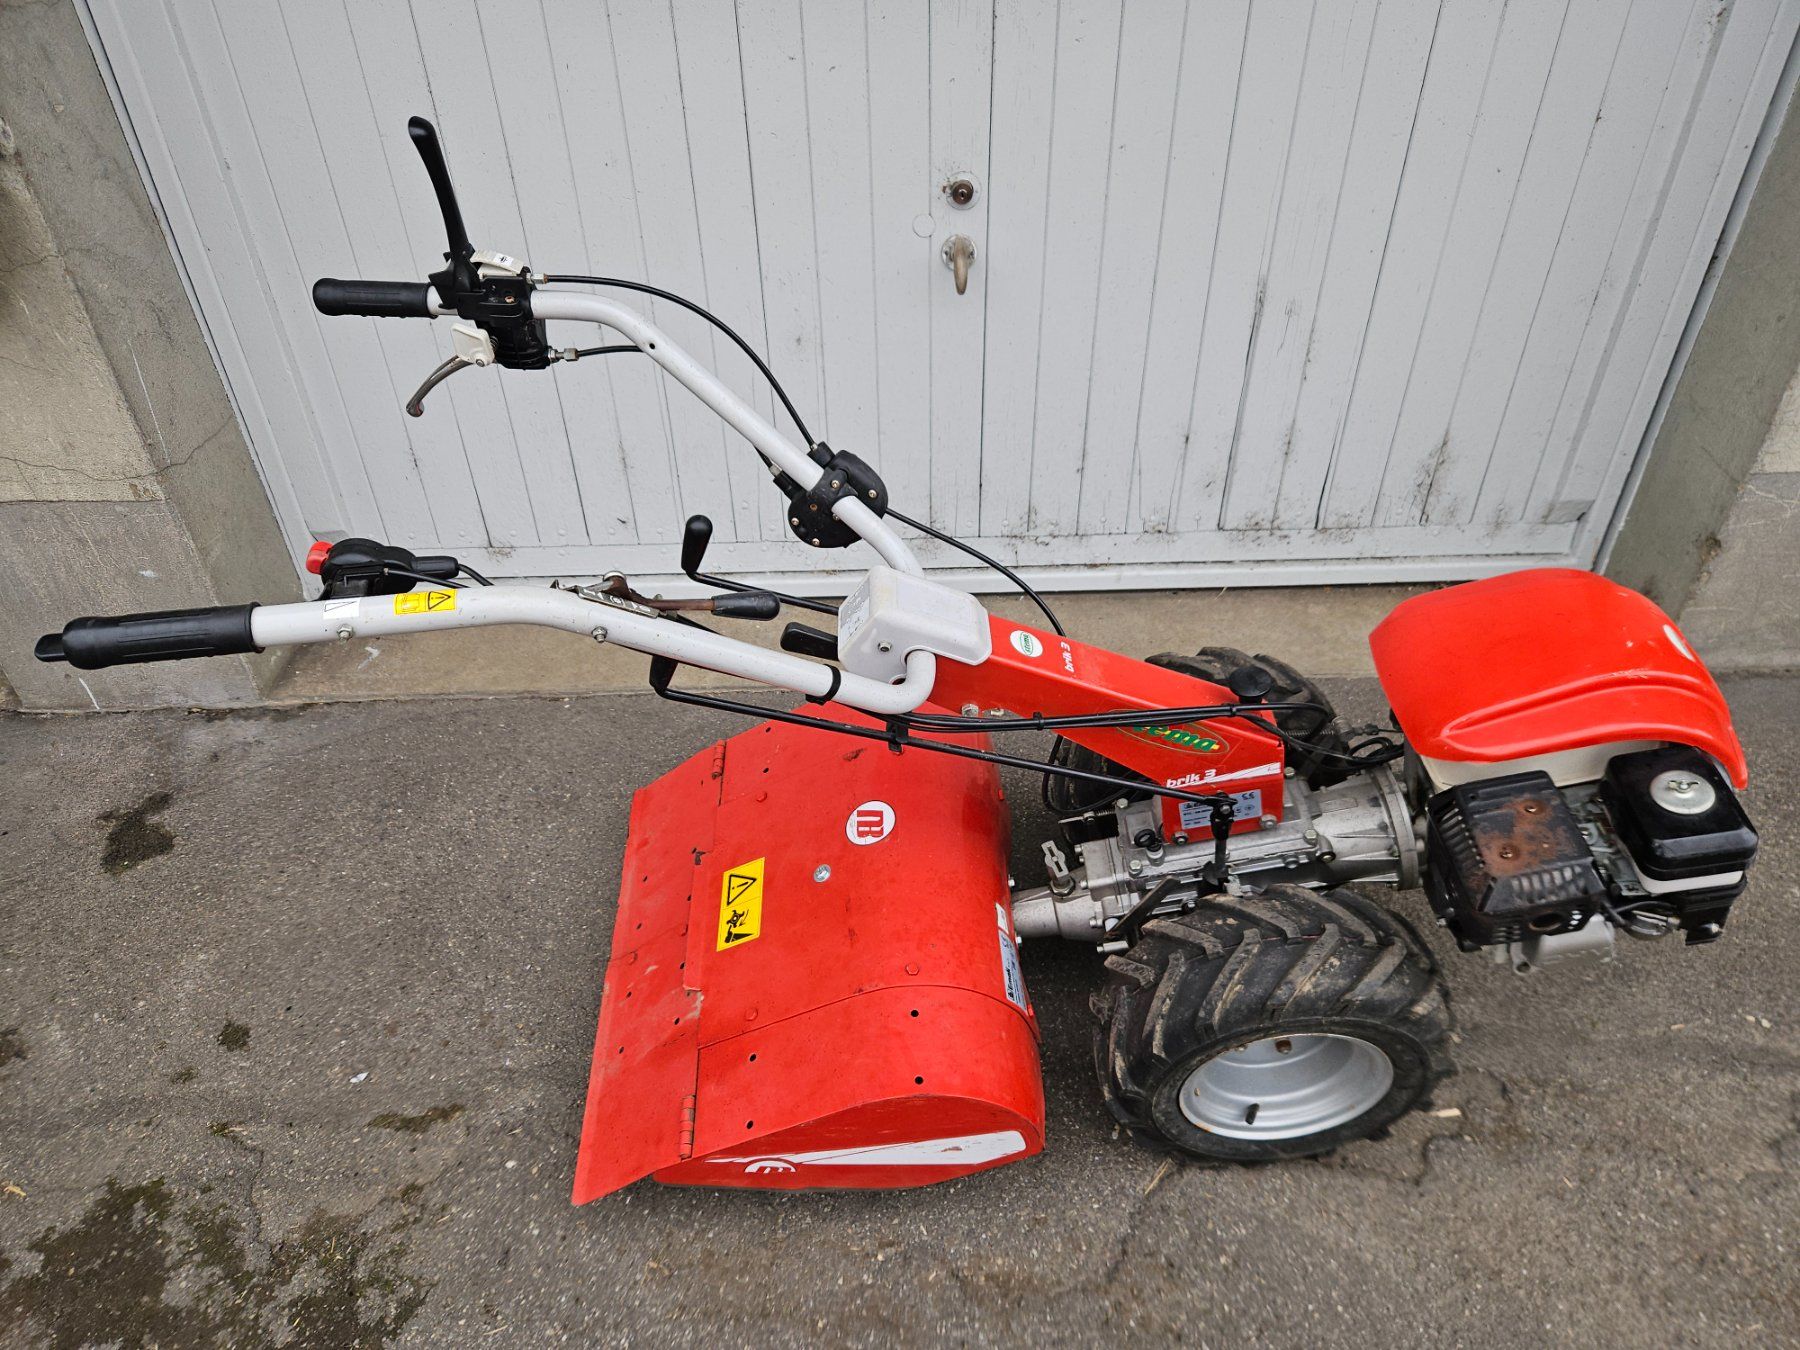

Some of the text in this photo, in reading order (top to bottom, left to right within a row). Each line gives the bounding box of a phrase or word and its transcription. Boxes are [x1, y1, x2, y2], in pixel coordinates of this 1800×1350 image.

[1060, 641, 1071, 652] 3
[1166, 768, 1217, 788] brik 3
